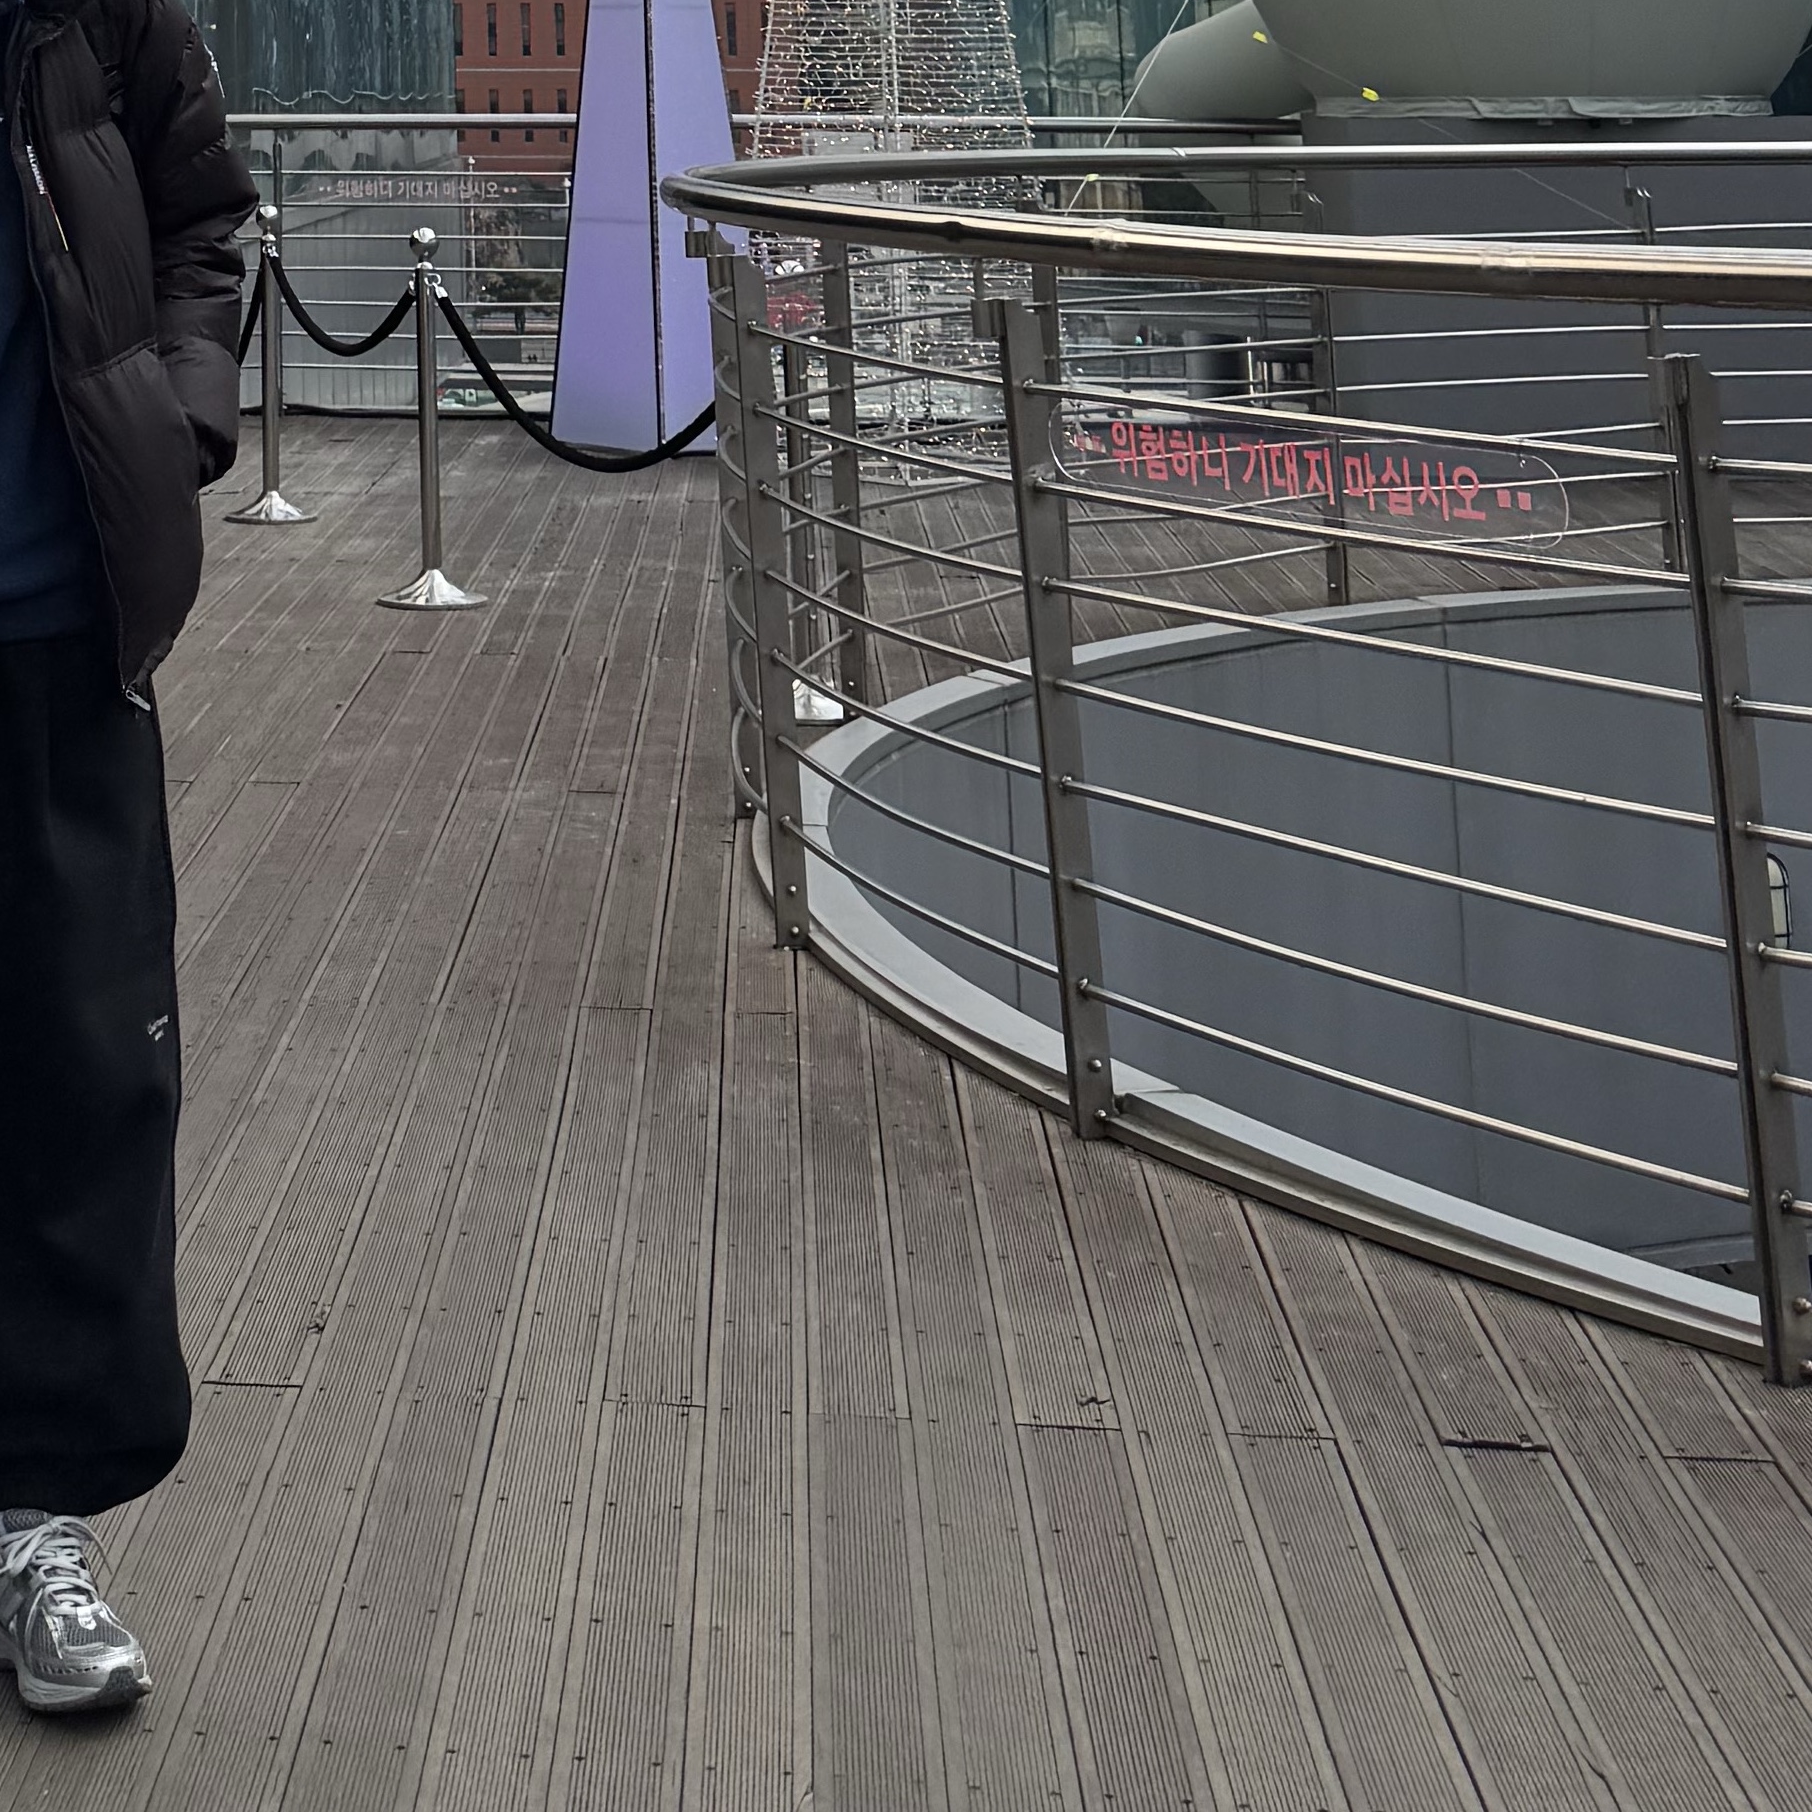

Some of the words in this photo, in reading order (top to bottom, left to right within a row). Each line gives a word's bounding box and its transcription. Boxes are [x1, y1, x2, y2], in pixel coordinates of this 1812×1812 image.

[397, 179, 438, 199] 기대지
[1109, 420, 1231, 492] 위험하니
[1239, 435, 1337, 506] 기대지
[1343, 450, 1487, 522] 마십시오
